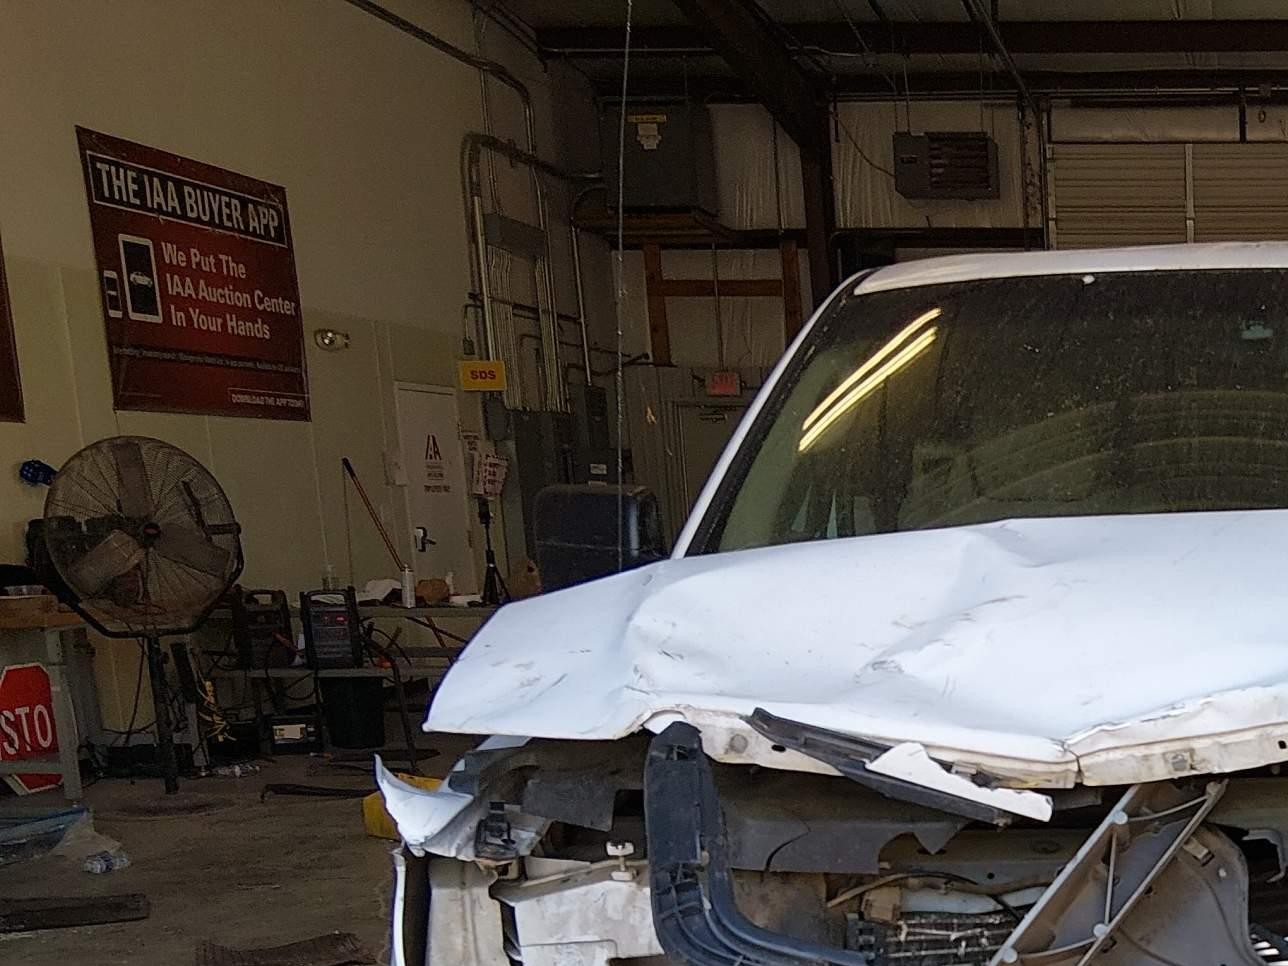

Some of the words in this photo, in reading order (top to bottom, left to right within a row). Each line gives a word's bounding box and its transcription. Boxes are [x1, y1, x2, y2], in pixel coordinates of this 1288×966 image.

[96, 162, 141, 205] THE
[143, 174, 182, 216] IAA
[183, 185, 245, 231] BUYER
[248, 202, 279, 239] APP
[161, 241, 187, 267] We
[189, 247, 217, 273] Put
[218, 254, 246, 279] The
[166, 273, 197, 300] IAA
[198, 279, 252, 308] Auction
[254, 289, 297, 316] Center
[170, 304, 186, 328] In
[188, 307, 224, 333] Your
[226, 313, 271, 340] Hands
[470, 369, 497, 380] SDS
[0, 704, 53, 755] STO
